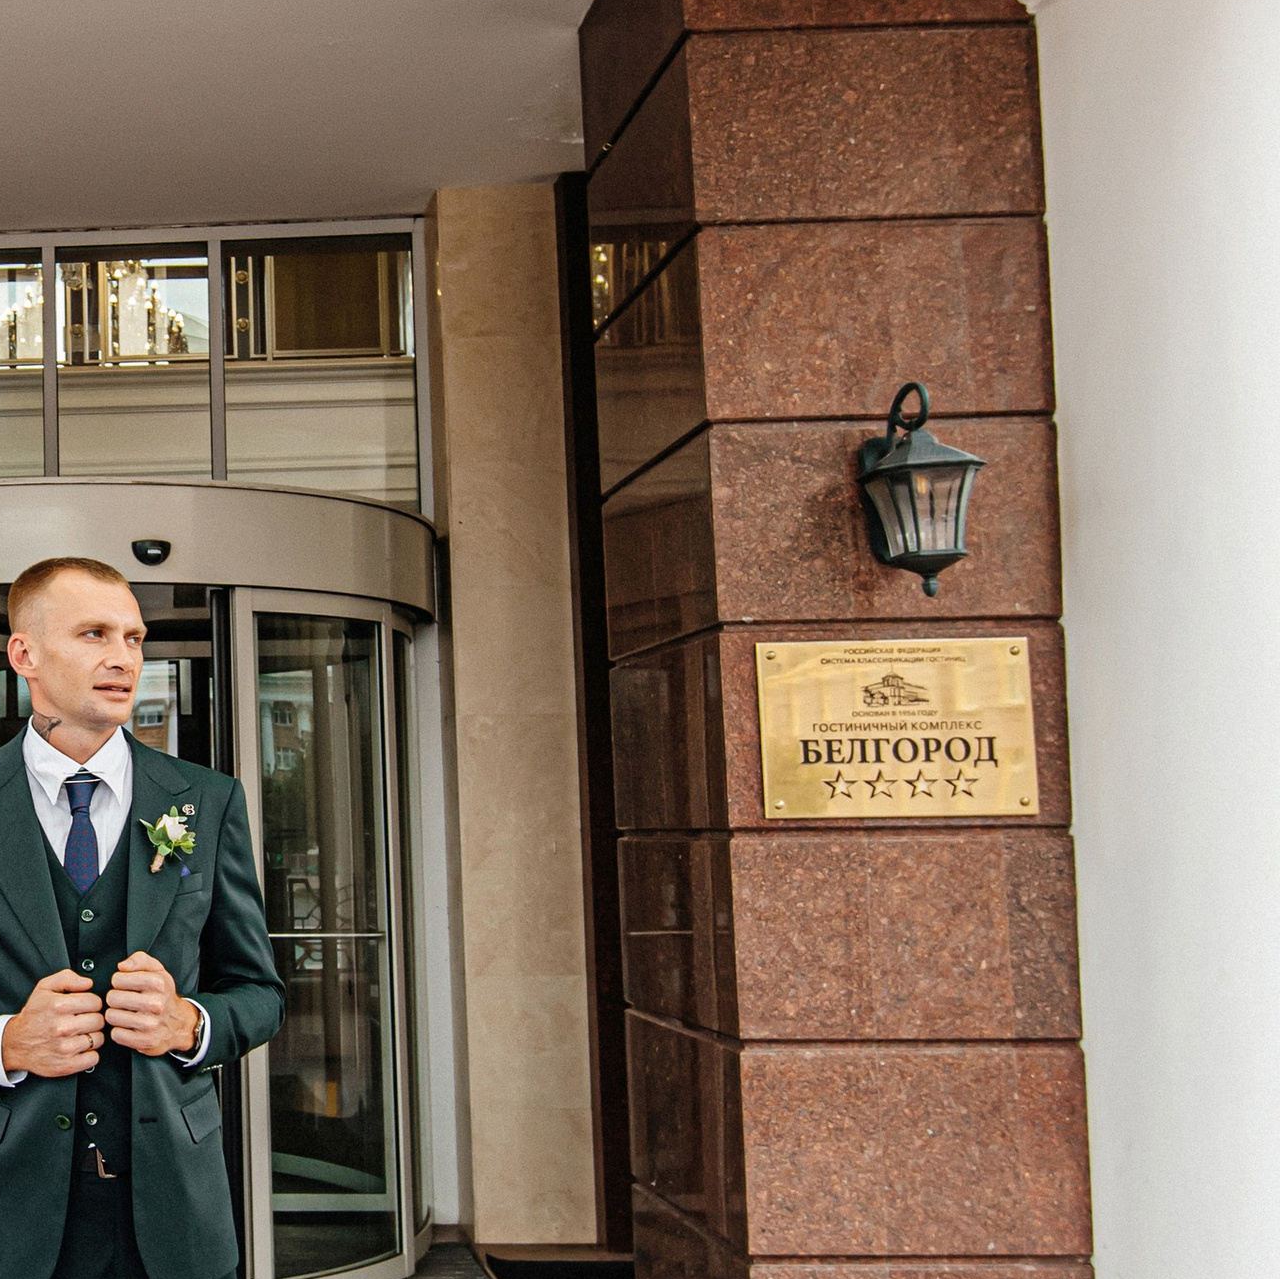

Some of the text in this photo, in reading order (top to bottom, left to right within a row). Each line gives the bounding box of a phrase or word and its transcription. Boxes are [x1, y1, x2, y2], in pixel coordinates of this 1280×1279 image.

[843, 646, 941, 655] РОССИЙСКАЯ ФЕДЕРАЦИЯ
[820, 657, 856, 665] СИСТЕМА
[851, 710, 890, 718] ОСНОВАН
[812, 720, 983, 733] ГОСТИНИЧНЫЙ КОМПЛЕКС
[799, 736, 998, 768] БЕЛГОРОД
